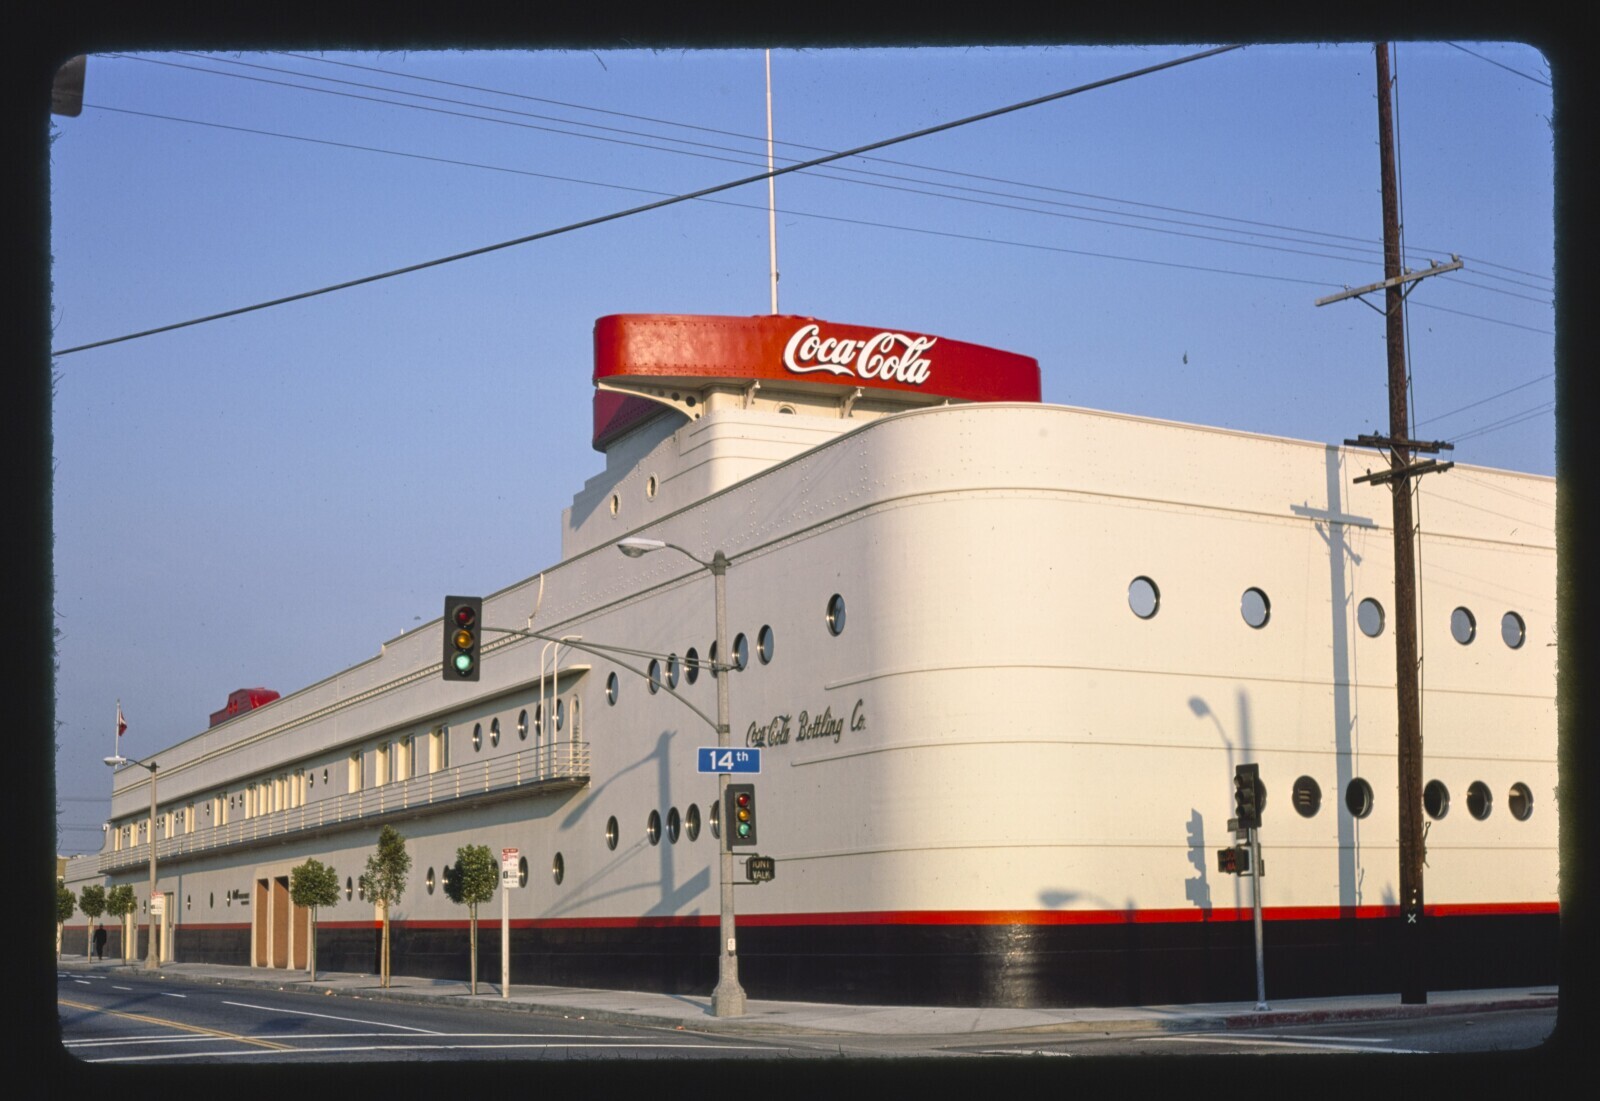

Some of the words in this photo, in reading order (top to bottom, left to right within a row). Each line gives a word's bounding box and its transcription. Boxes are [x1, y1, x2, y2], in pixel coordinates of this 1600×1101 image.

[784, 324, 937, 384] Coca-Cola
[796, 705, 844, 744] Bottling
[851, 698, 866, 731] Co.
[709, 750, 749, 770] 14th
